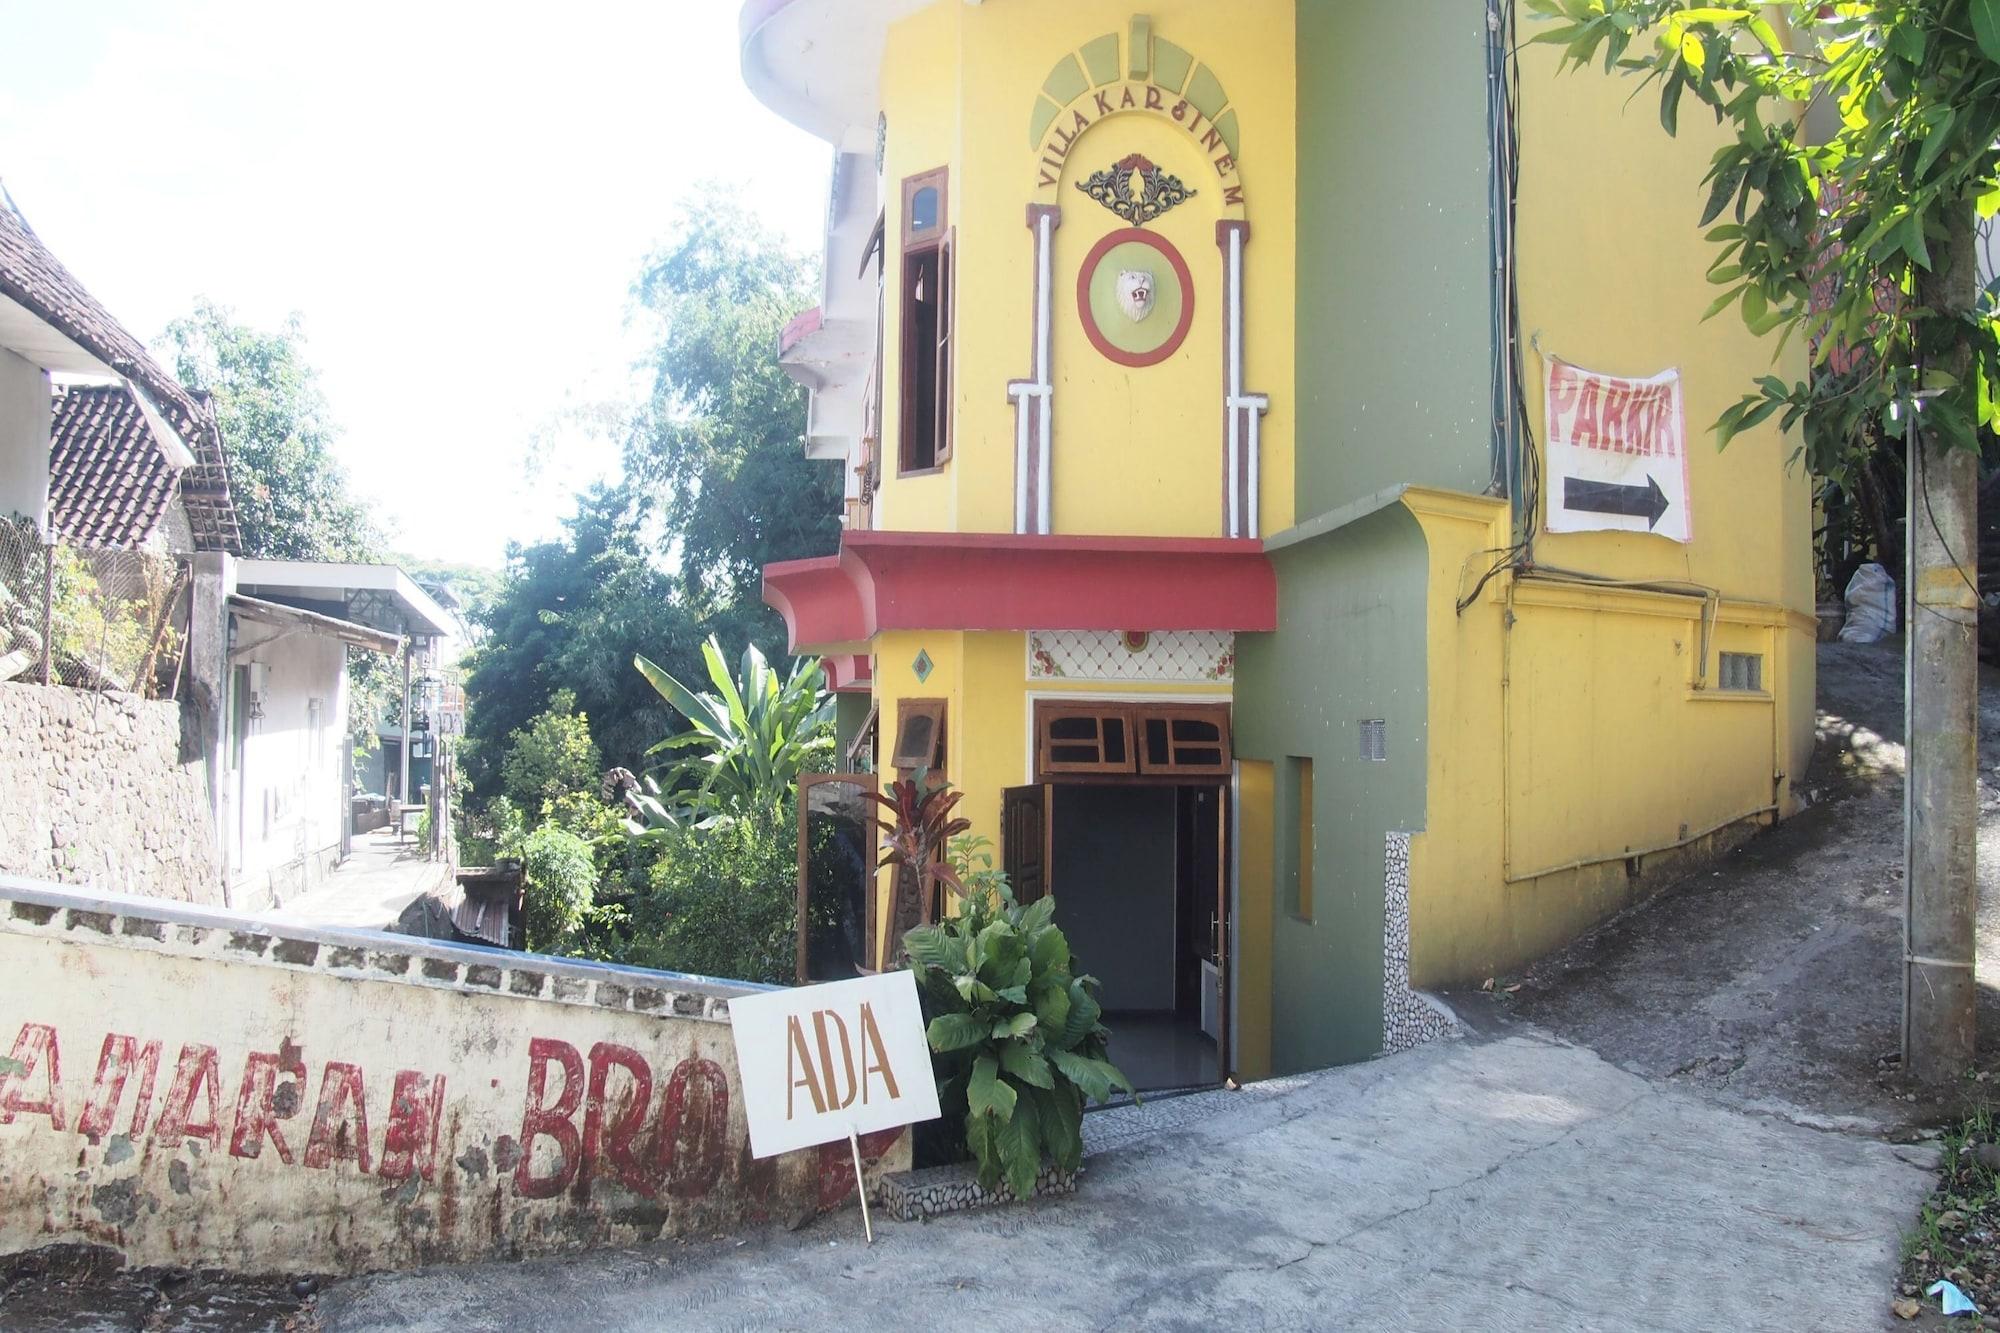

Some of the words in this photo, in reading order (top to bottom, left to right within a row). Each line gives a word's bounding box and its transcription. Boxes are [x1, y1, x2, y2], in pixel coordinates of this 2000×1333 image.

[1038, 109, 1090, 189] VILLA
[1093, 85, 1245, 207] KARSINEM
[1549, 362, 1677, 458] PARKIR
[786, 1000, 902, 1121] ADA
